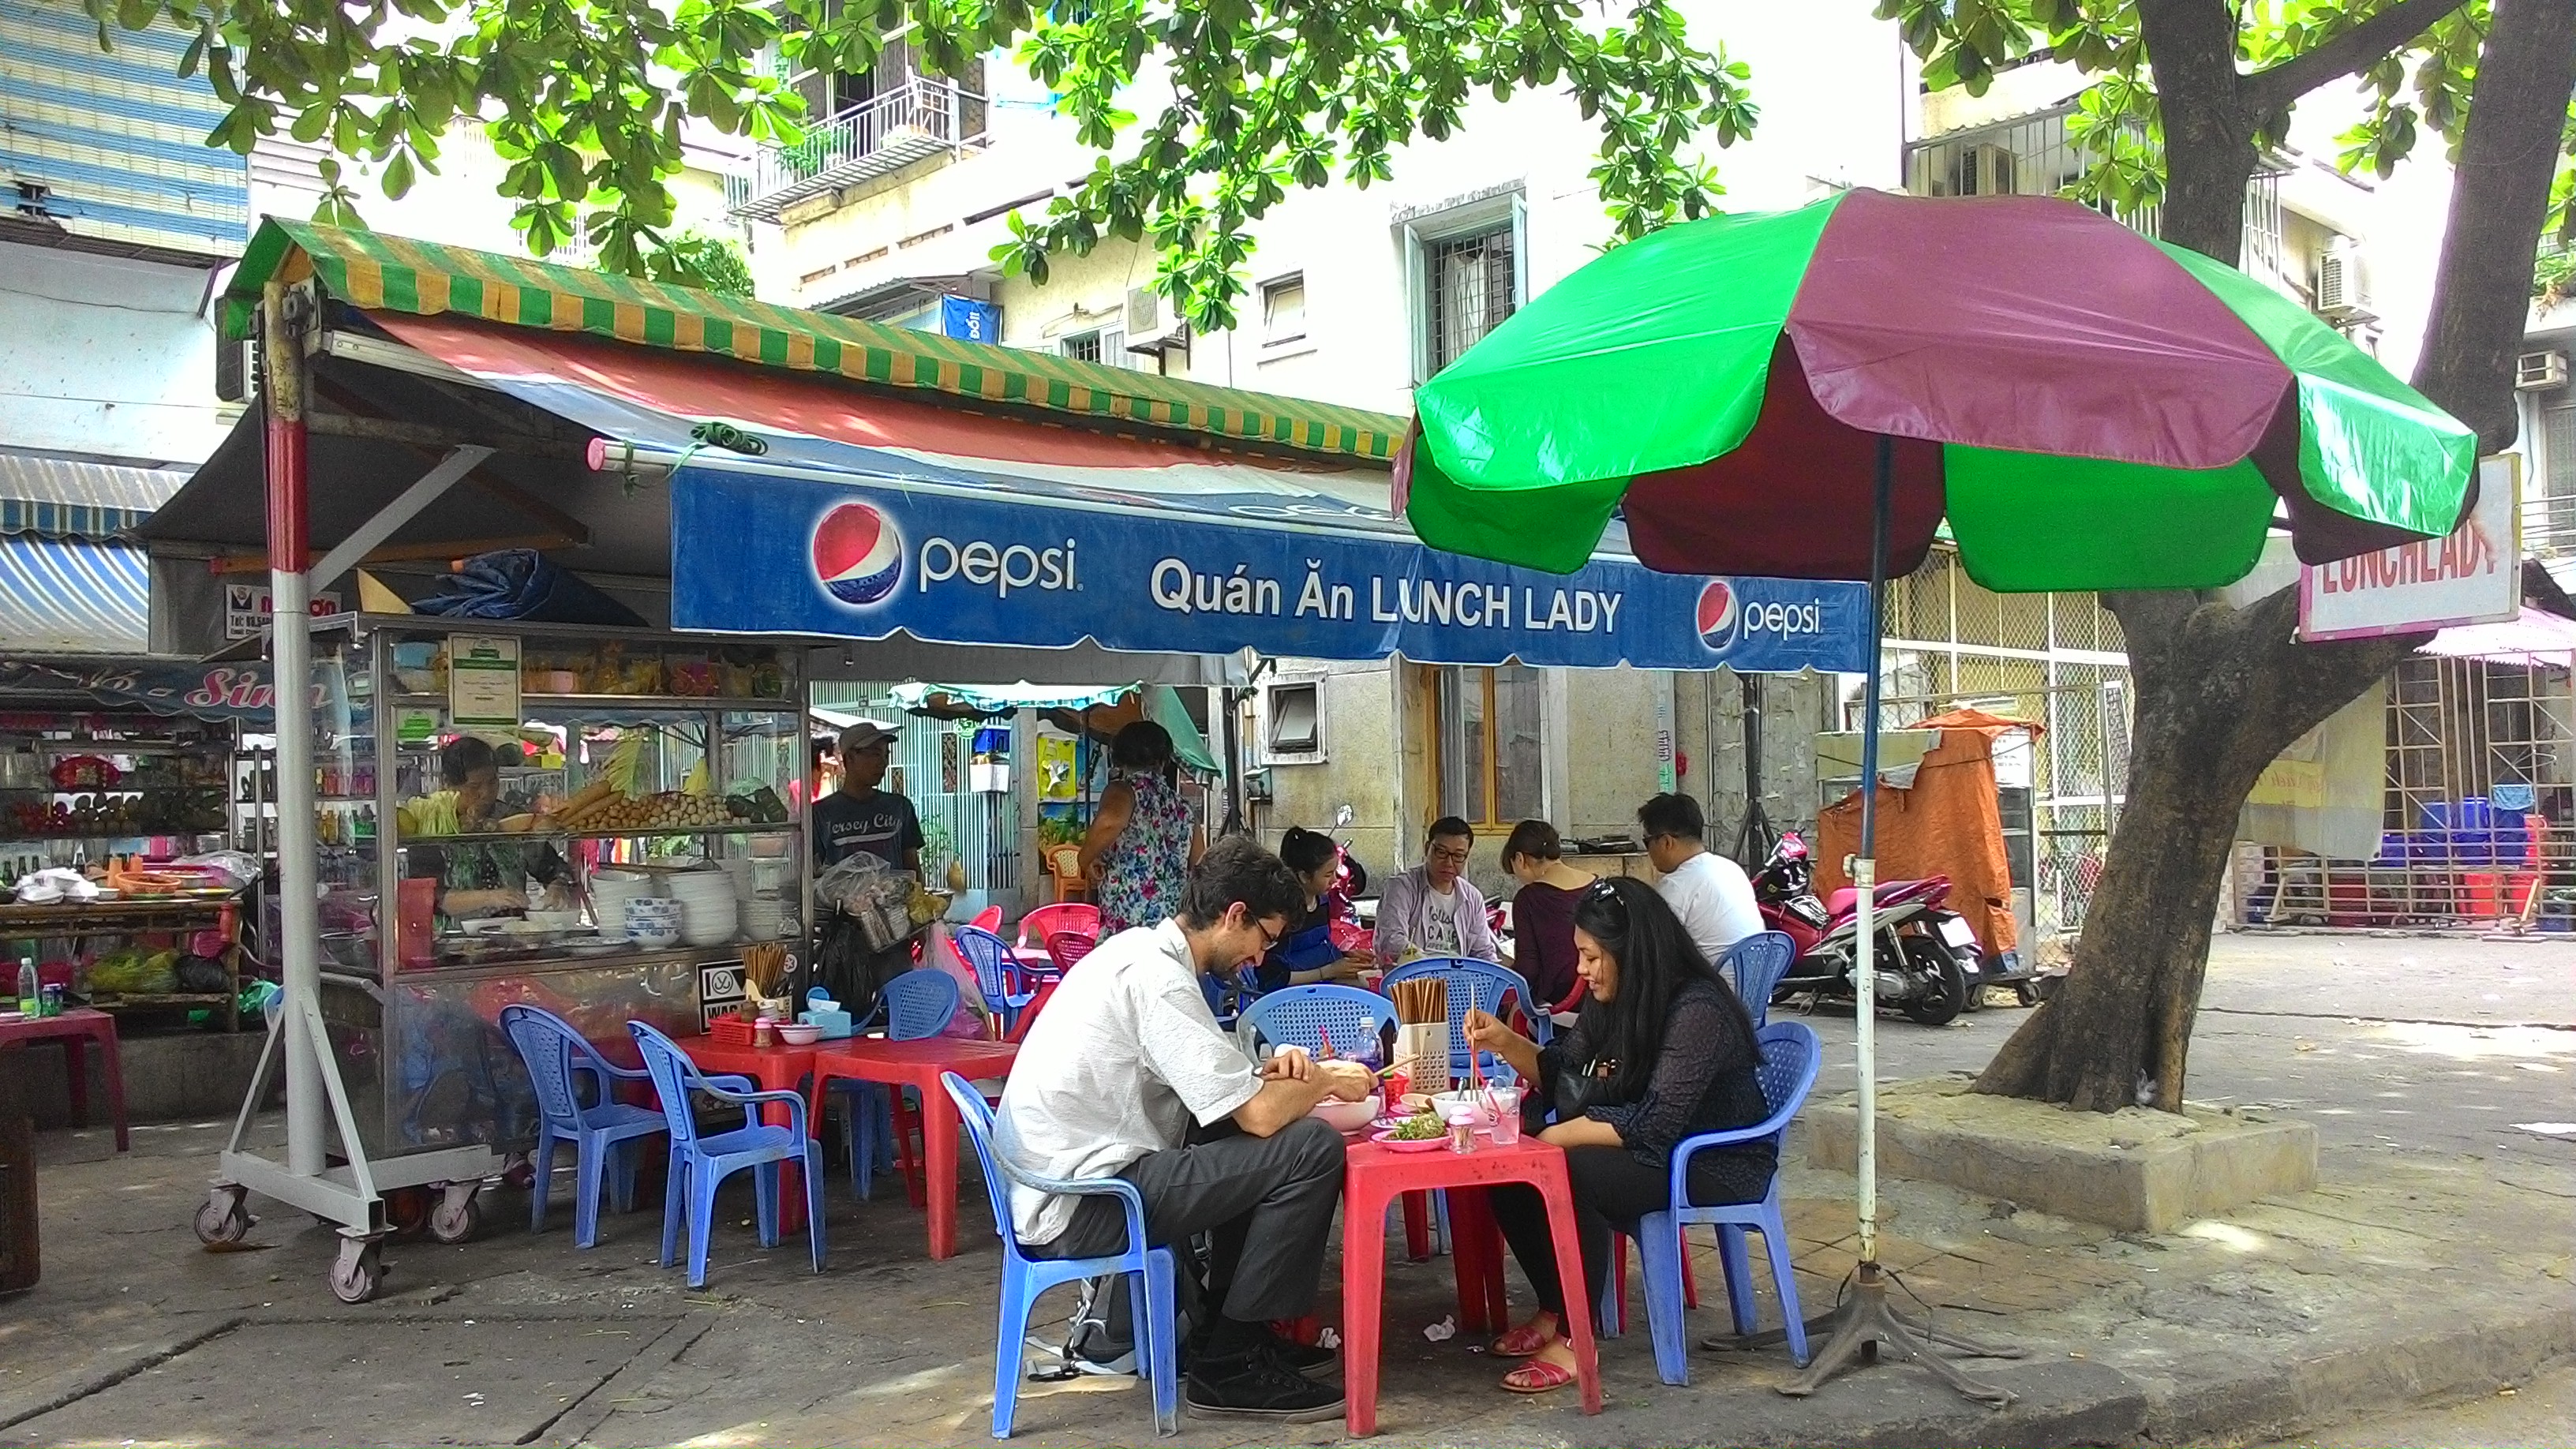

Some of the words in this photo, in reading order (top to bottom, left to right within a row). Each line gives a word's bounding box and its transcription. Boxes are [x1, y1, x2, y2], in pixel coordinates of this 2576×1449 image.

[919, 538, 1076, 599] pepsi
[1149, 557, 1281, 616] Quán
[1295, 557, 1354, 620] Ăn
[1372, 576, 1511, 629] LUNCH
[1524, 587, 1623, 634] LADY
[1743, 597, 1820, 642] pepsi
[826, 820, 870, 835] Jersey
[873, 813, 903, 832] City
